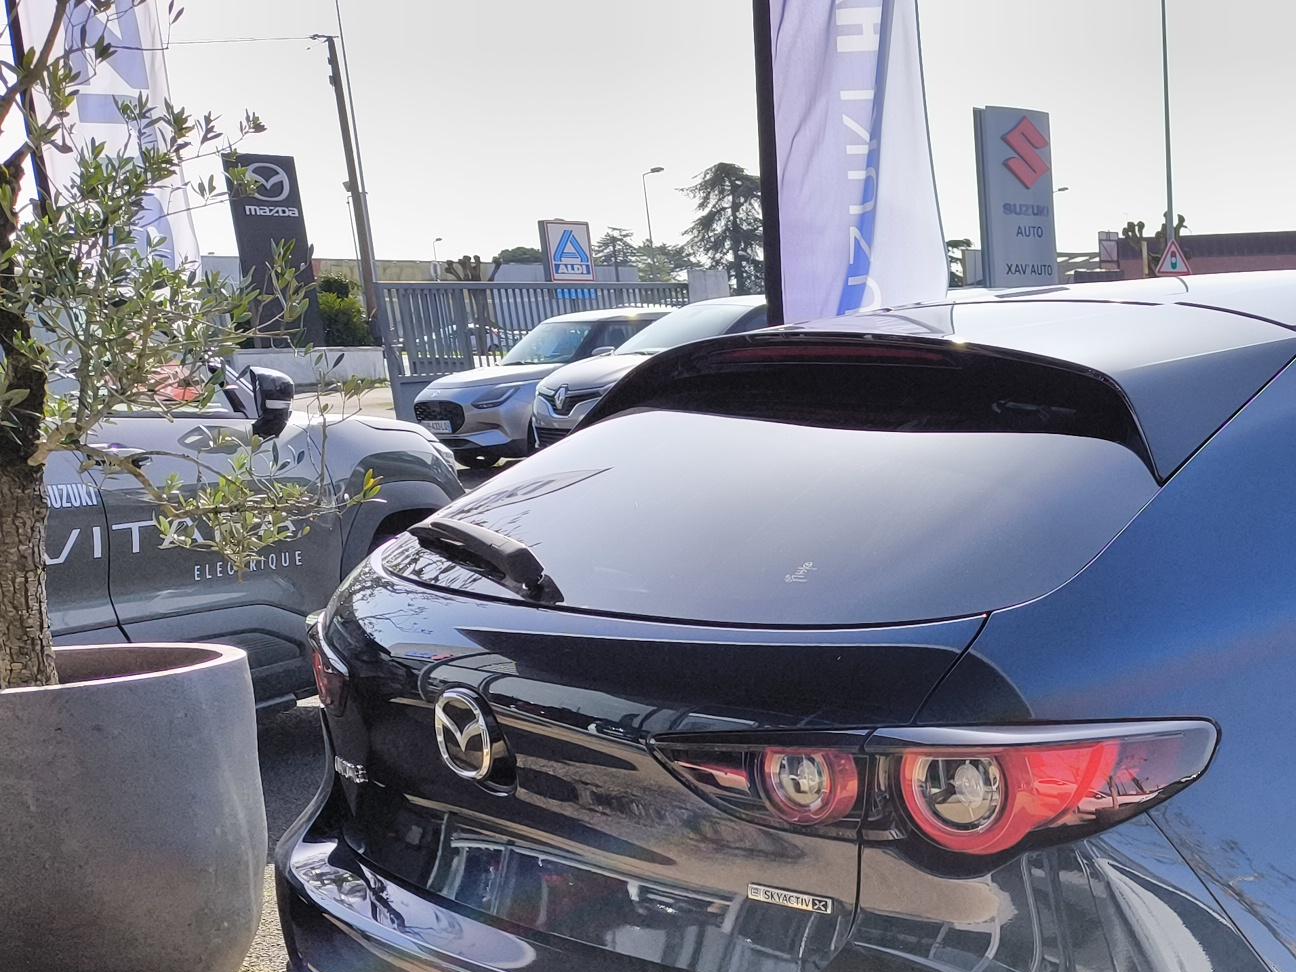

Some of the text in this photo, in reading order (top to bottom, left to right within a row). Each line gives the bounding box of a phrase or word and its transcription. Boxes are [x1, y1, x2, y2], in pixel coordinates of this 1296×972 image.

[840, 88, 882, 316] UZUKI
[1002, 203, 1049, 216] SUZUKI
[1015, 225, 1044, 238] AUTO
[558, 264, 588, 274] ALDI
[44, 483, 98, 509] UZUKI
[194, 551, 303, 581] ELECRIQUE
